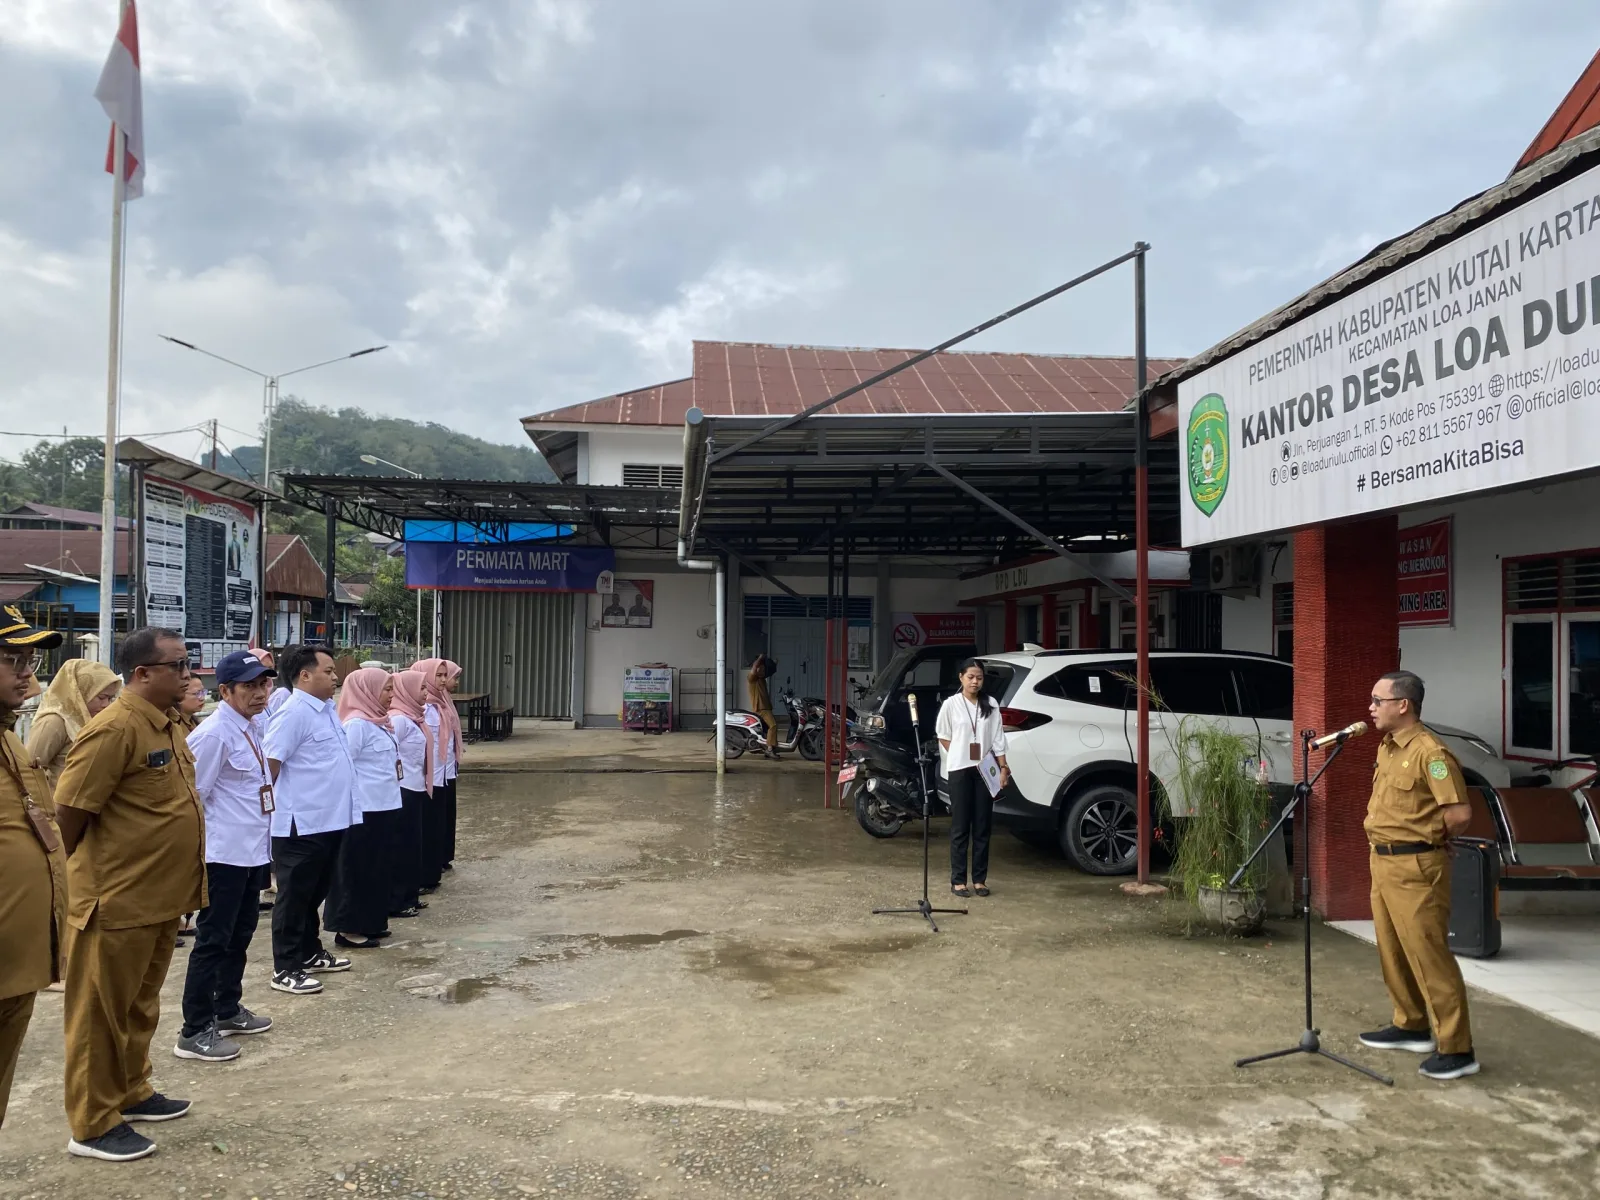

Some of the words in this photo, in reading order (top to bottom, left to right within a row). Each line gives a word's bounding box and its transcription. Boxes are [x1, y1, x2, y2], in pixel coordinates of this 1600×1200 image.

[1249, 326, 1333, 386] PEMERINTAH
[1338, 272, 1441, 345] KABUPATEN
[1448, 239, 1510, 294] KUTAI
[1349, 313, 1428, 364] KECAMATAN
[1432, 300, 1462, 328] LOA
[1466, 272, 1522, 314] JANAN
[1241, 384, 1334, 449] KANTOR
[1342, 349, 1424, 414] DESA
[1434, 315, 1510, 381] LOA
[1306, 429, 1351, 453] Perjuangan
[1364, 418, 1378, 436] RT.
[1380, 415, 1387, 430] 5
[1389, 407, 1414, 428] Kode
[1417, 401, 1436, 419] Pos
[1439, 383, 1486, 412] 755391
[1396, 429, 1416, 447] +62
[1418, 422, 1440, 443] 811
[1443, 412, 1473, 436] 5567
[1477, 404, 1502, 427] 967
[1371, 439, 1525, 490] BersamaKitaBisa
[456, 549, 524, 570] PERMATA
[529, 552, 570, 571] MART
[474, 576, 493, 585] Menjual
[1409, 554, 1447, 573] MEROKOK
[1422, 590, 1447, 611] AREA
